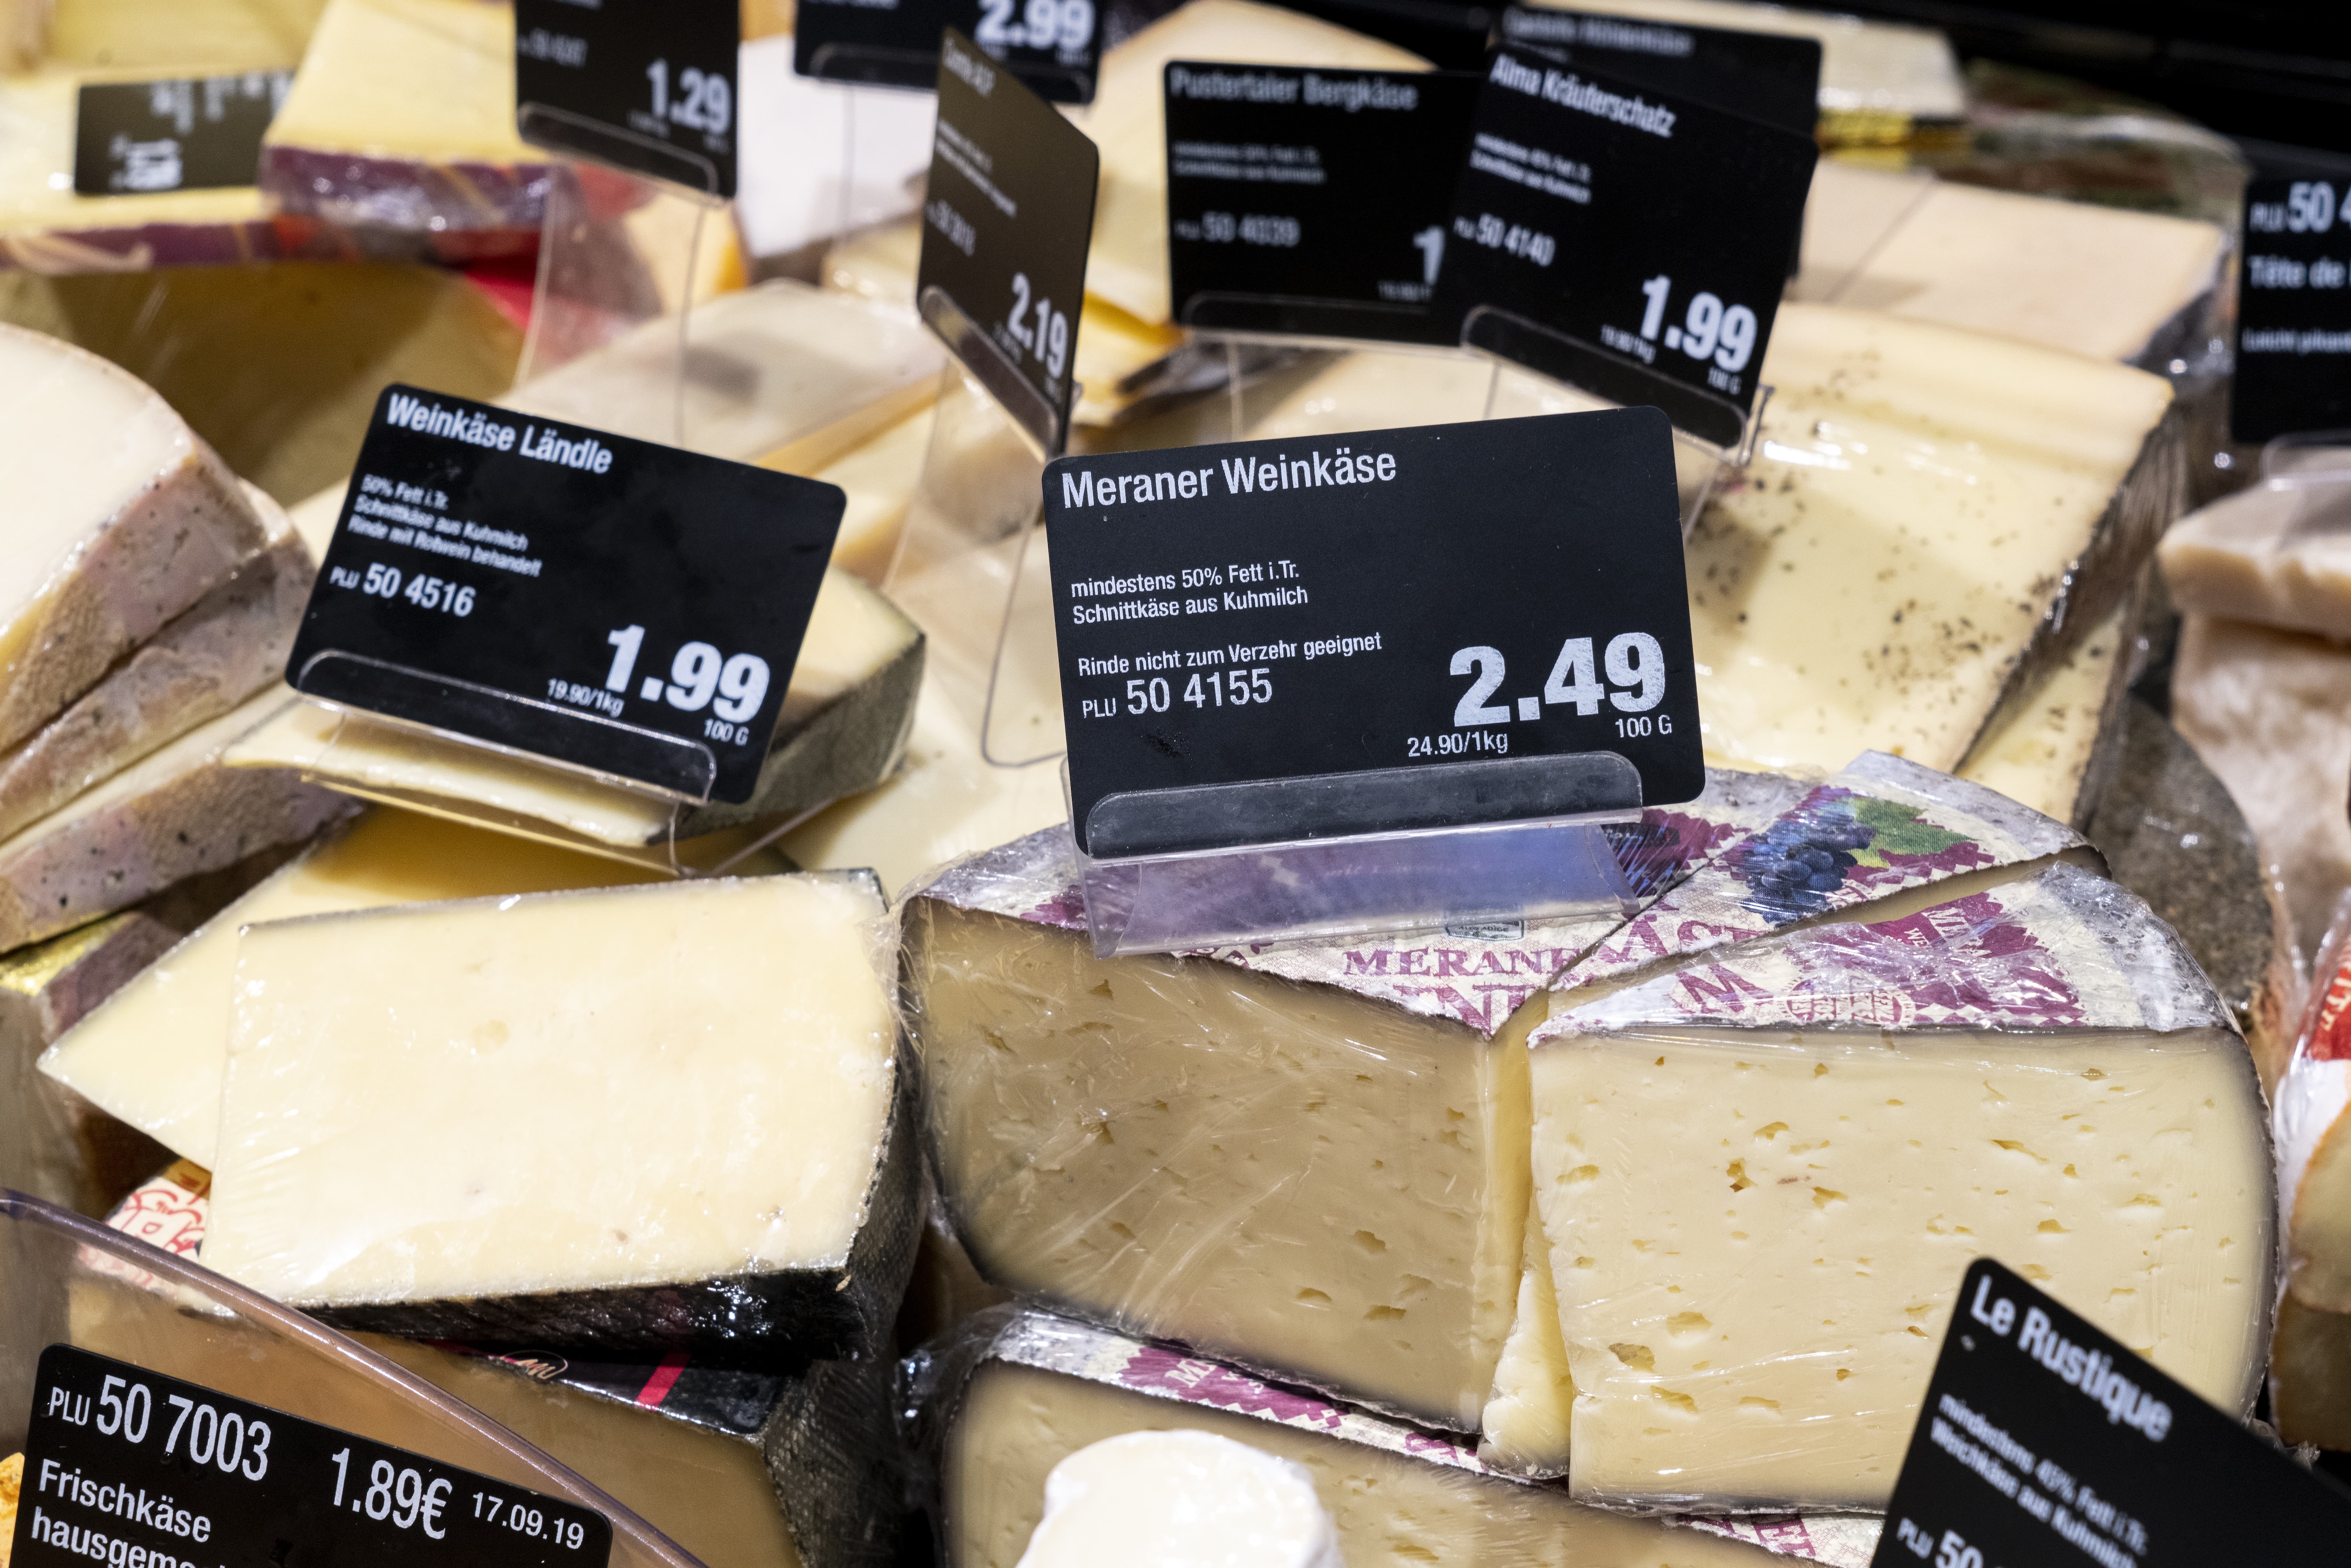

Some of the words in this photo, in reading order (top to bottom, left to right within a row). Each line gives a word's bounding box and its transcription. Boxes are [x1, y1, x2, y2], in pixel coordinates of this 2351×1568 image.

[975, 0, 1096, 51] 2.99
[646, 60, 732, 134] 1.29
[1304, 75, 1417, 111] Bergkäse
[1491, 55, 1541, 95] Alma
[1542, 71, 1675, 137] Kräuterschatz
[1476, 214, 1504, 247] 50
[2286, 182, 2334, 231] 50
[1006, 274, 1067, 378] 2.19
[1640, 276, 1757, 372] 1.99
[387, 394, 515, 450] Weinkäse
[520, 425, 612, 473] Ländle
[395, 482, 424, 504] Fett
[1062, 468, 1213, 508] Meraner
[1221, 448, 1396, 494] Weinkäse
[348, 515, 388, 538] Rinde
[389, 528, 414, 544] mit
[472, 546, 542, 576] behandelt
[355, 495, 434, 528] Schnittkäse
[435, 517, 462, 535] aus
[463, 521, 528, 551] Kuhmilch
[331, 567, 360, 589] PLU
[363, 563, 401, 598] 50
[405, 575, 475, 616] 4516
[1072, 574, 1176, 597] mindestens
[1182, 567, 1222, 588] 50%
[1229, 564, 1263, 583] Fett
[1269, 560, 1299, 579] i.Tr.
[1073, 599, 1179, 624] Schnittkäse
[1186, 598, 1217, 614] aus
[1224, 586, 1308, 610] Kuhmilch
[605, 625, 770, 723] 1.99
[1079, 655, 1129, 676] Rinde
[1136, 651, 1181, 670] nicht
[1186, 650, 1224, 666] zum
[1229, 640, 1297, 662] Verzehr
[1304, 632, 1382, 660] geeignet
[1450, 632, 1665, 726] 2.49
[549, 679, 624, 717] 19.90/1kg
[1082, 698, 1116, 718] PLU
[1127, 678, 1170, 714] 50
[1184, 668, 1272, 708] 4155
[705, 719, 736, 741] 100
[735, 727, 749, 745] G
[1407, 731, 1507, 757] 24.90/1kg
[1616, 717, 1651, 738] 100
[1658, 715, 1672, 734] G
[1971, 1276, 2015, 1335] Le
[2019, 1308, 2171, 1440] Rustique
[49, 1387, 90, 1425] PLU
[97, 1375, 151, 1443] 50
[166, 1395, 271, 1481] 7003
[39, 1459, 210, 1542] Frischkäse
[332, 1448, 452, 1539] 1.89€
[473, 1492, 584, 1549] 17.09.19
[1898, 1519, 1933, 1558] PLU
